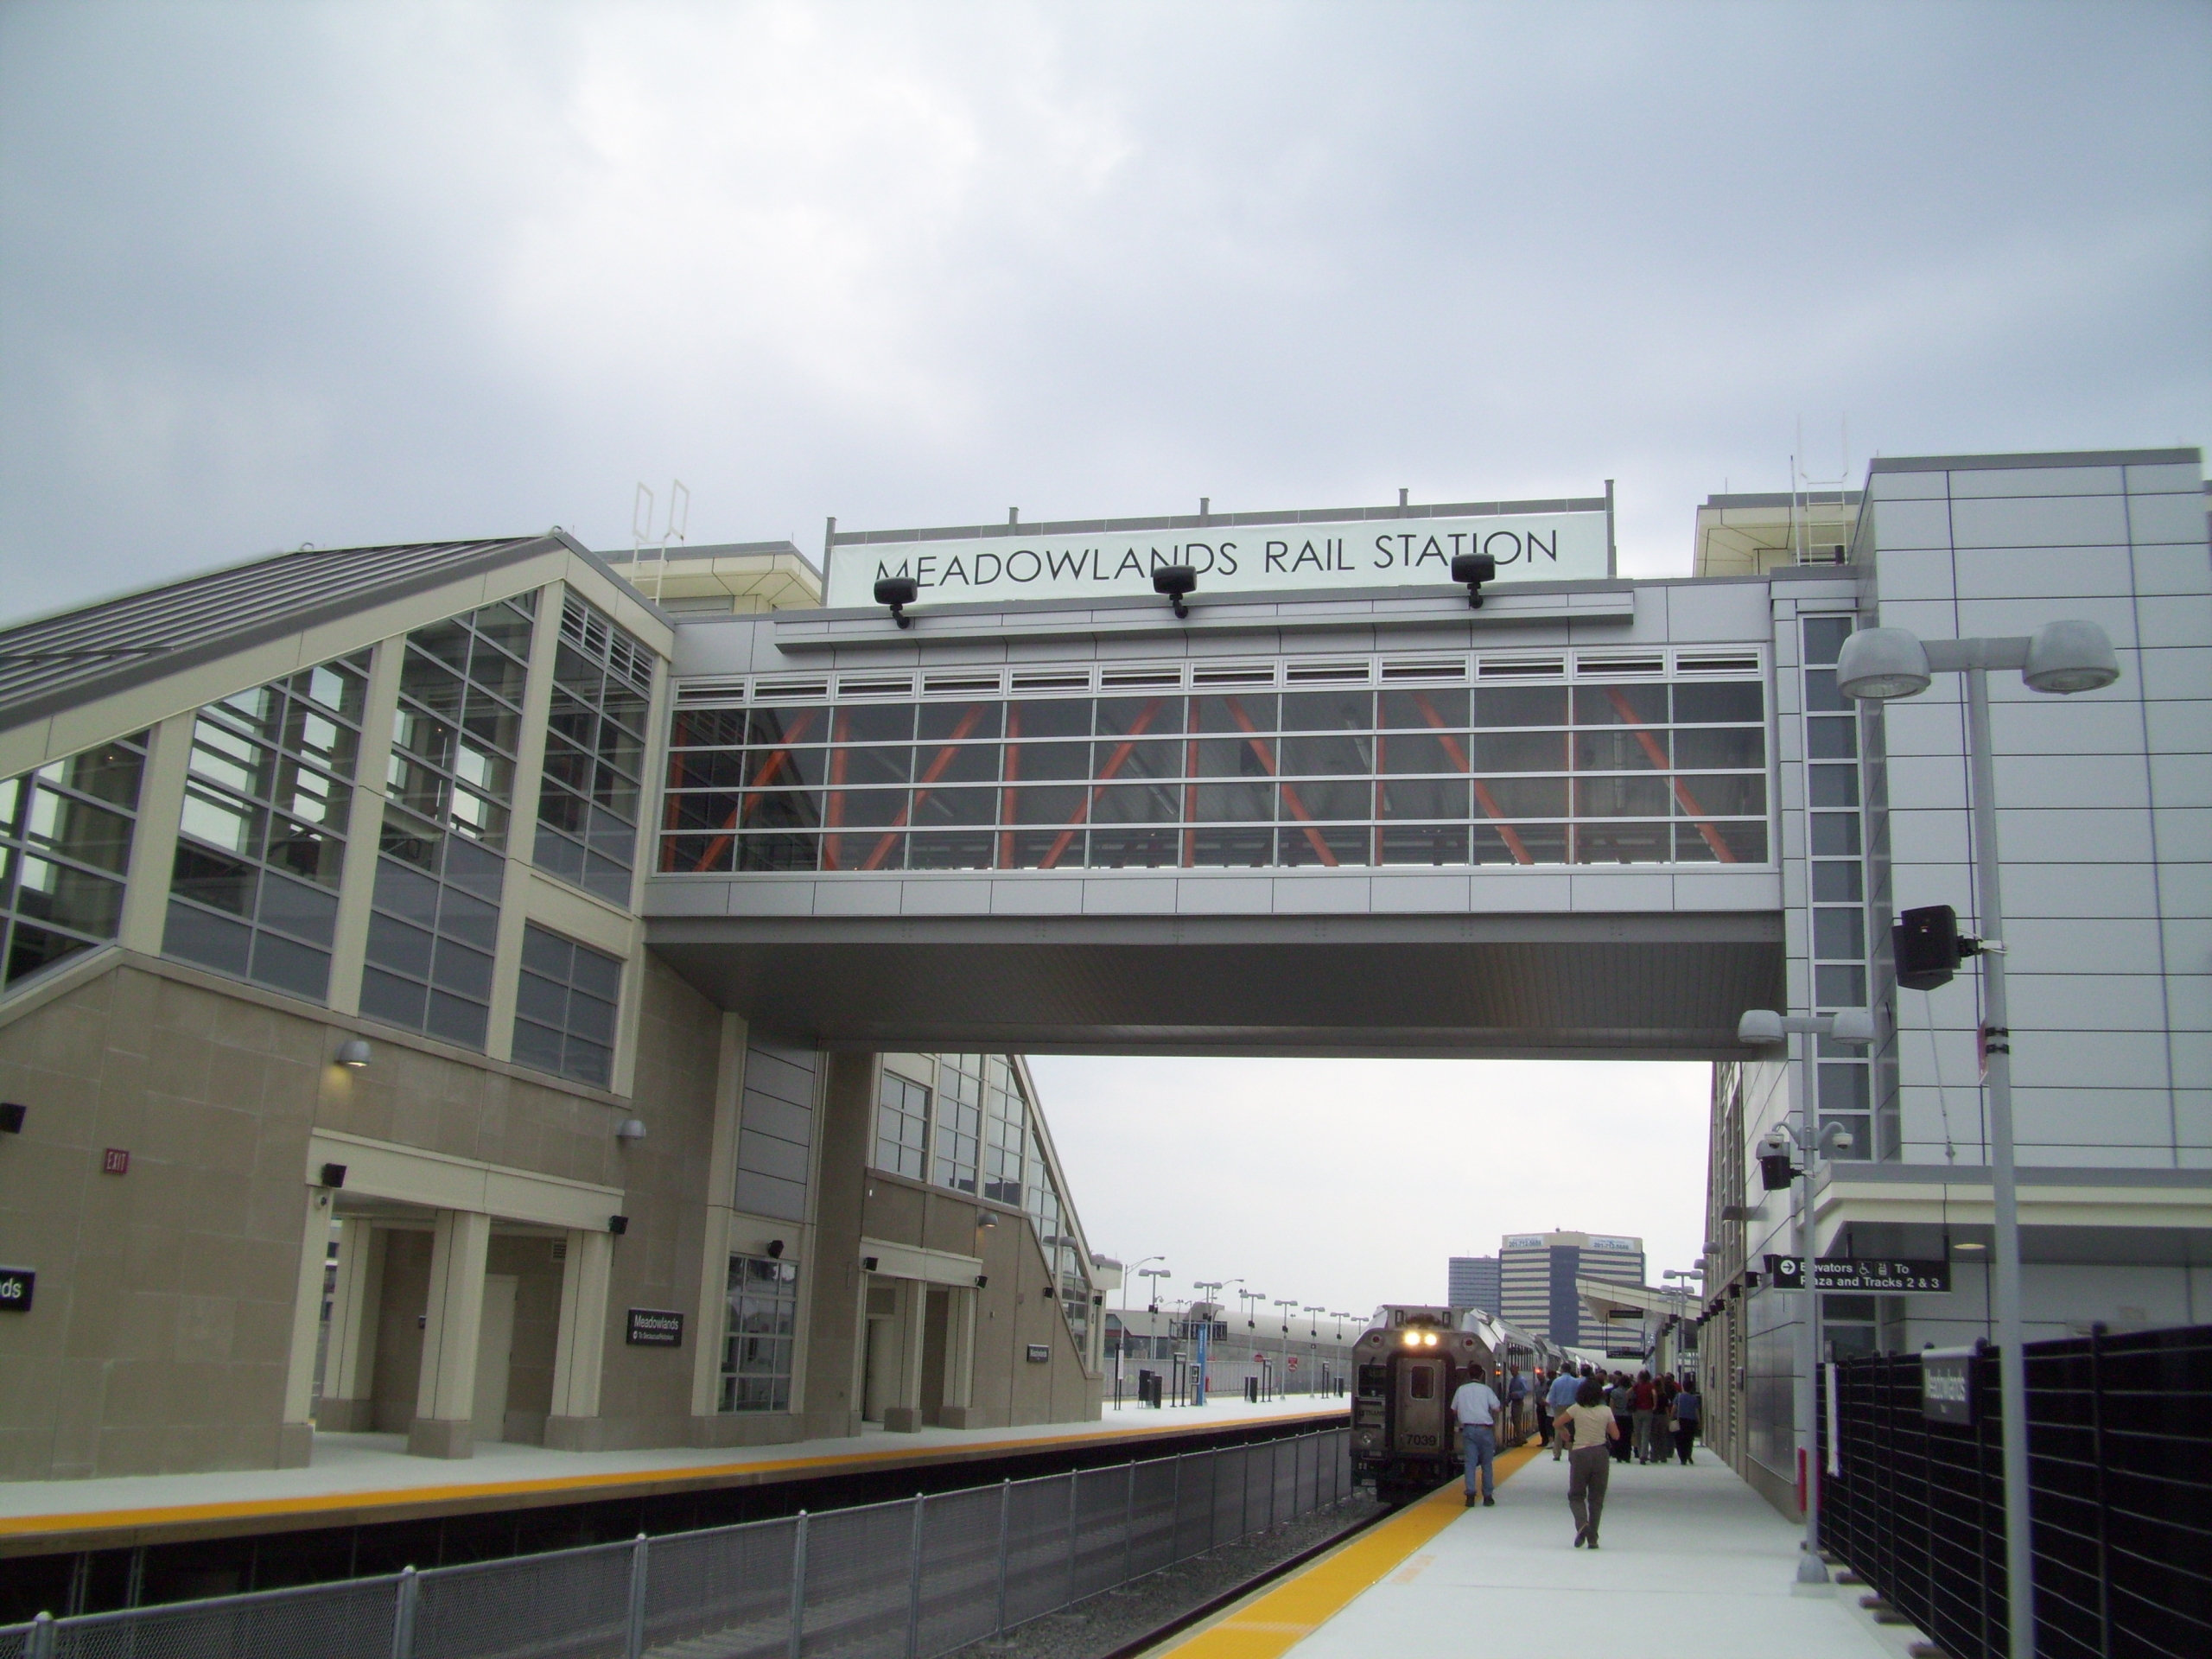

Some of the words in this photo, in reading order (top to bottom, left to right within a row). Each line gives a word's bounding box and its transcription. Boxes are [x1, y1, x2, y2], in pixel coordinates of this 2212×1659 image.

[875, 542, 1237, 588] MEADOWLANDS
[1265, 538, 1355, 573] RAIL
[1373, 530, 1556, 569] STATION
[107, 1152, 126, 1171] EXIT
[1800, 1262, 1853, 1274] Evators
[1895, 1264, 1910, 1274] To
[1800, 1275, 1833, 1287] Paza
[1837, 1276, 1859, 1287] and
[1864, 1277, 1902, 1287] Tracks
[1907, 1278, 1915, 1287] 2
[1918, 1278, 1928, 1288] &
[1931, 1279, 1940, 1288] 3
[634, 1314, 679, 1331] Meadowlands
[1407, 1434, 1436, 1446] 7039
